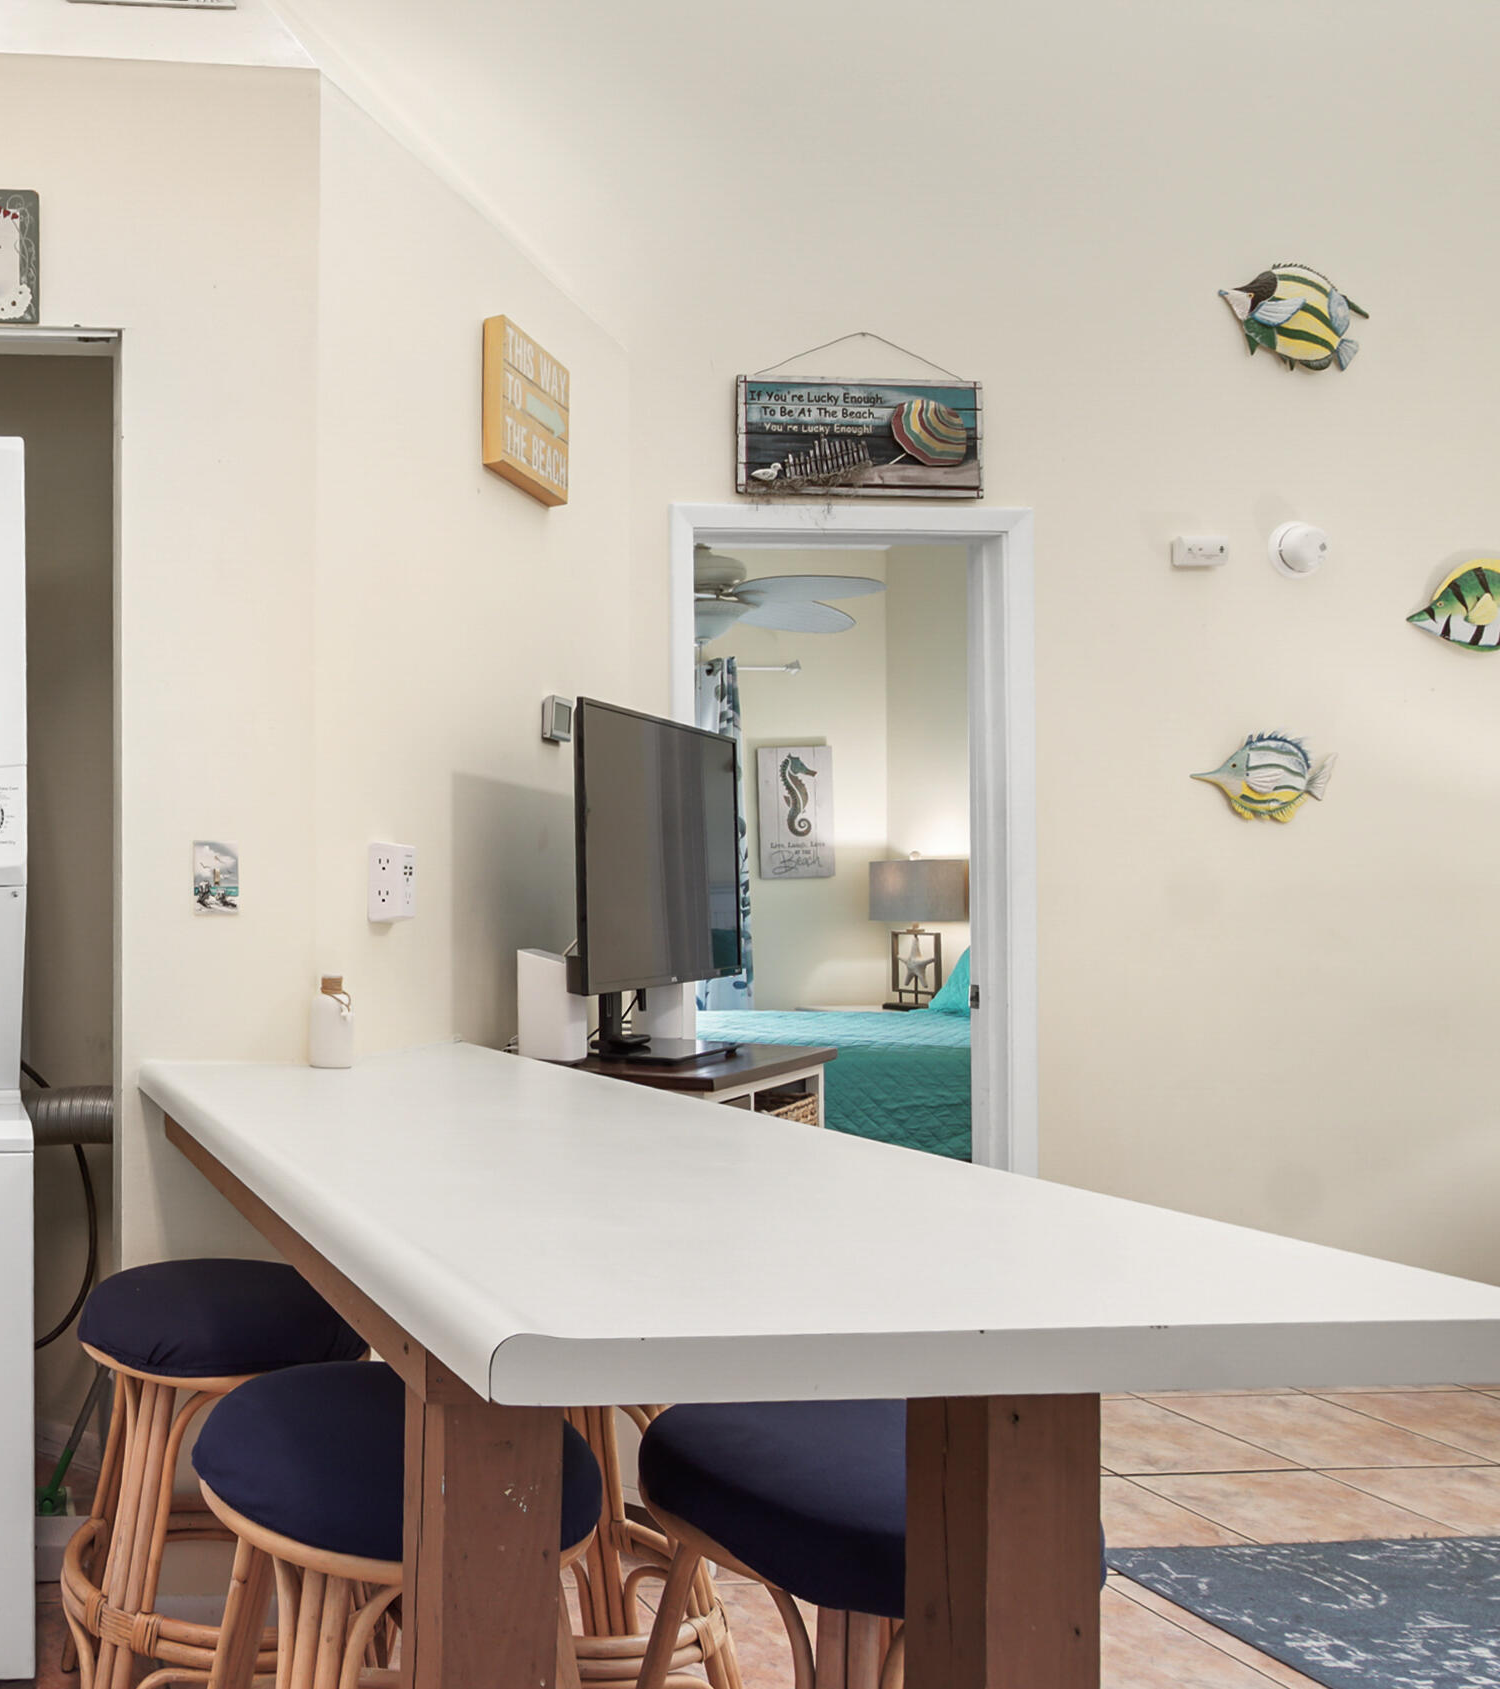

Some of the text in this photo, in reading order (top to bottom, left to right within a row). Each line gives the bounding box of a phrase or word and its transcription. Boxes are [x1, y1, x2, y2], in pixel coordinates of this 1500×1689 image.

[505, 325, 567, 404] THIS WAY
[505, 371, 523, 411] TO
[749, 390, 762, 401] If
[765, 390, 804, 403] You're
[807, 392, 840, 406] Lucky
[761, 406, 776, 417] To
[779, 407, 795, 417] Be
[798, 407, 813, 418] At
[816, 407, 839, 418] The
[763, 422, 874, 436] You're Lucky Enough!
[505, 415, 568, 490] THE BEACH
